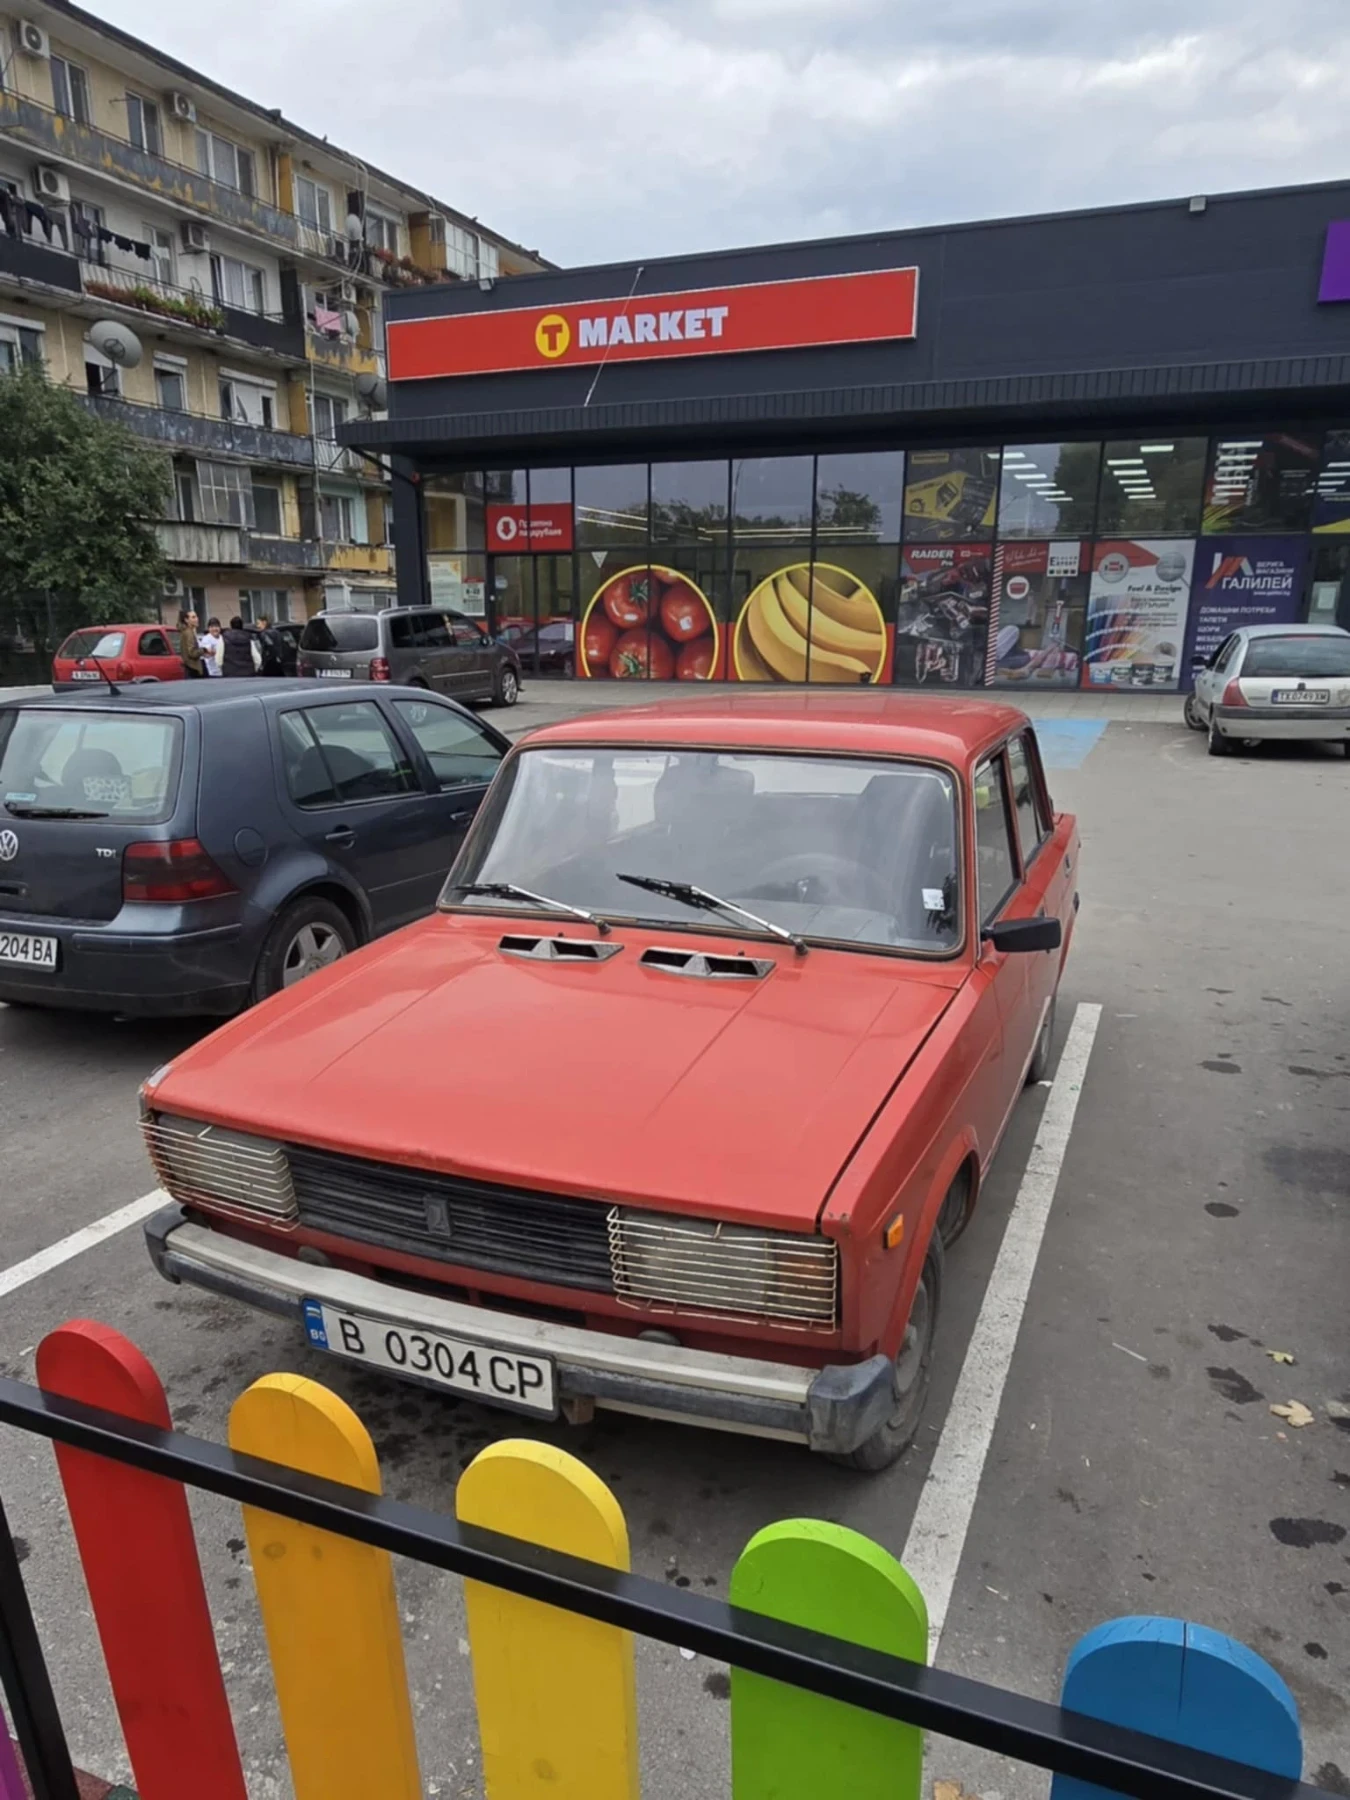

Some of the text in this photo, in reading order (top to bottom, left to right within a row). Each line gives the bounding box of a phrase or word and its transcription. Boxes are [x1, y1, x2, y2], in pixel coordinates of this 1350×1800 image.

[578, 306, 729, 348] MARKET
[911, 549, 954, 559] RAIDER
[1221, 575, 1293, 590] ГАЛИЛЕЙ
